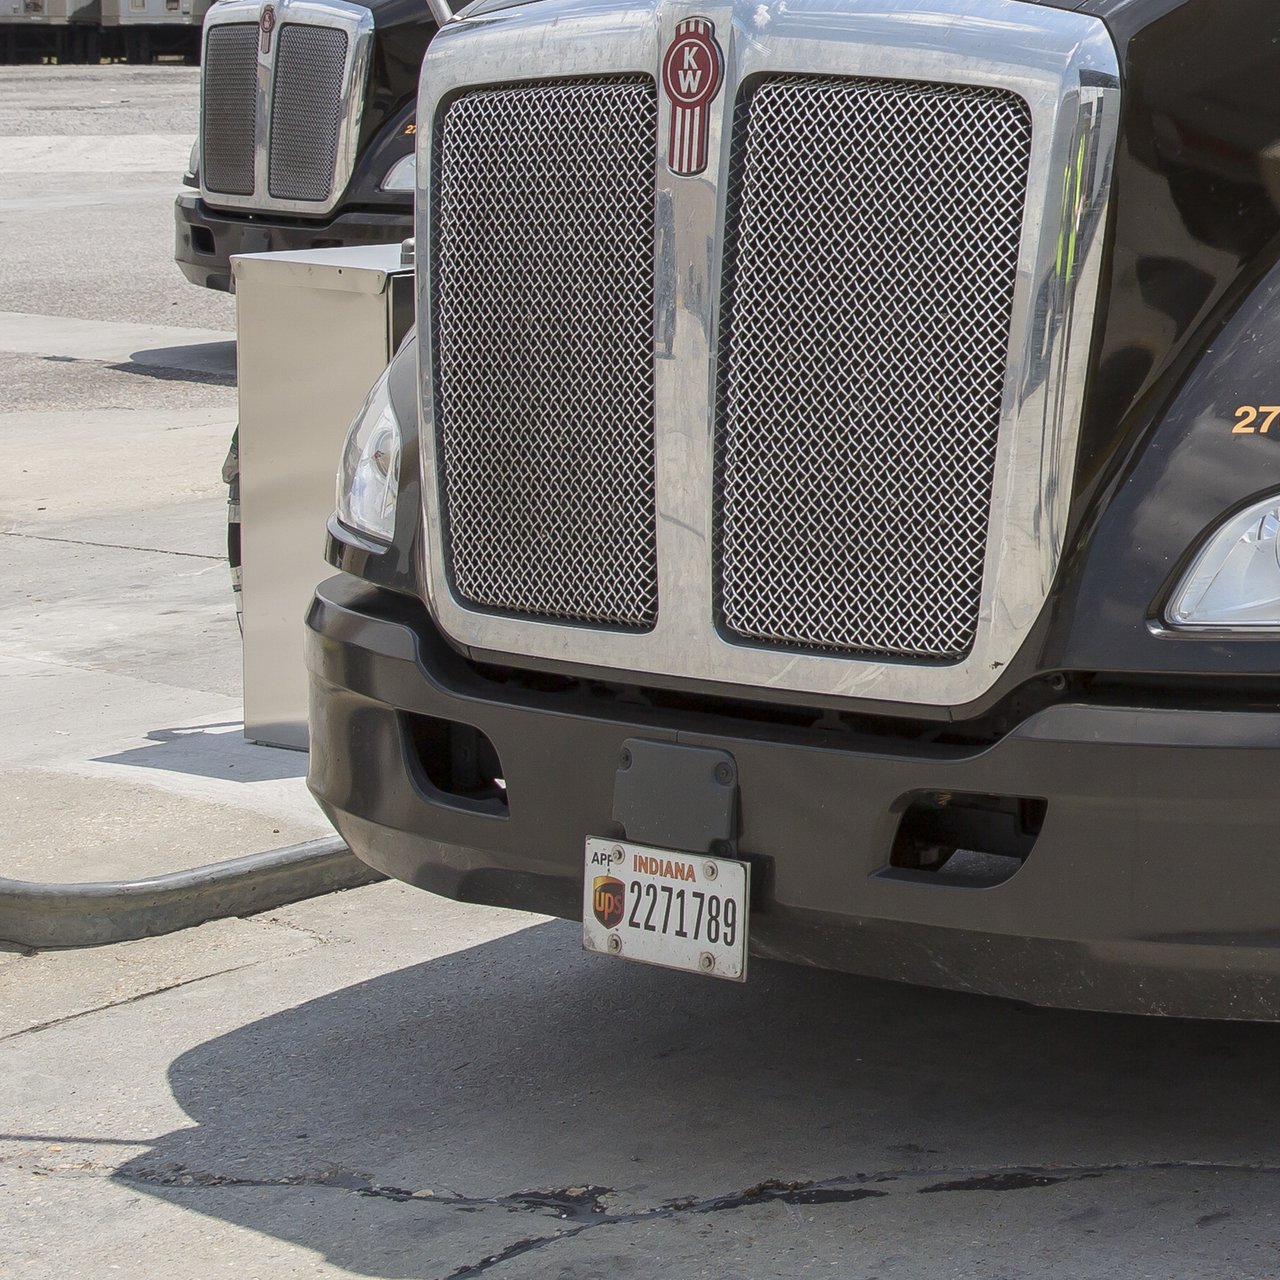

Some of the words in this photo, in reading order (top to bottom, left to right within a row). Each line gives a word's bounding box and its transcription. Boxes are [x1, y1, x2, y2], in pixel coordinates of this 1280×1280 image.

[633, 854, 697, 883] INDIANA
[595, 890, 624, 921] ups
[628, 880, 737, 947] 2271789
